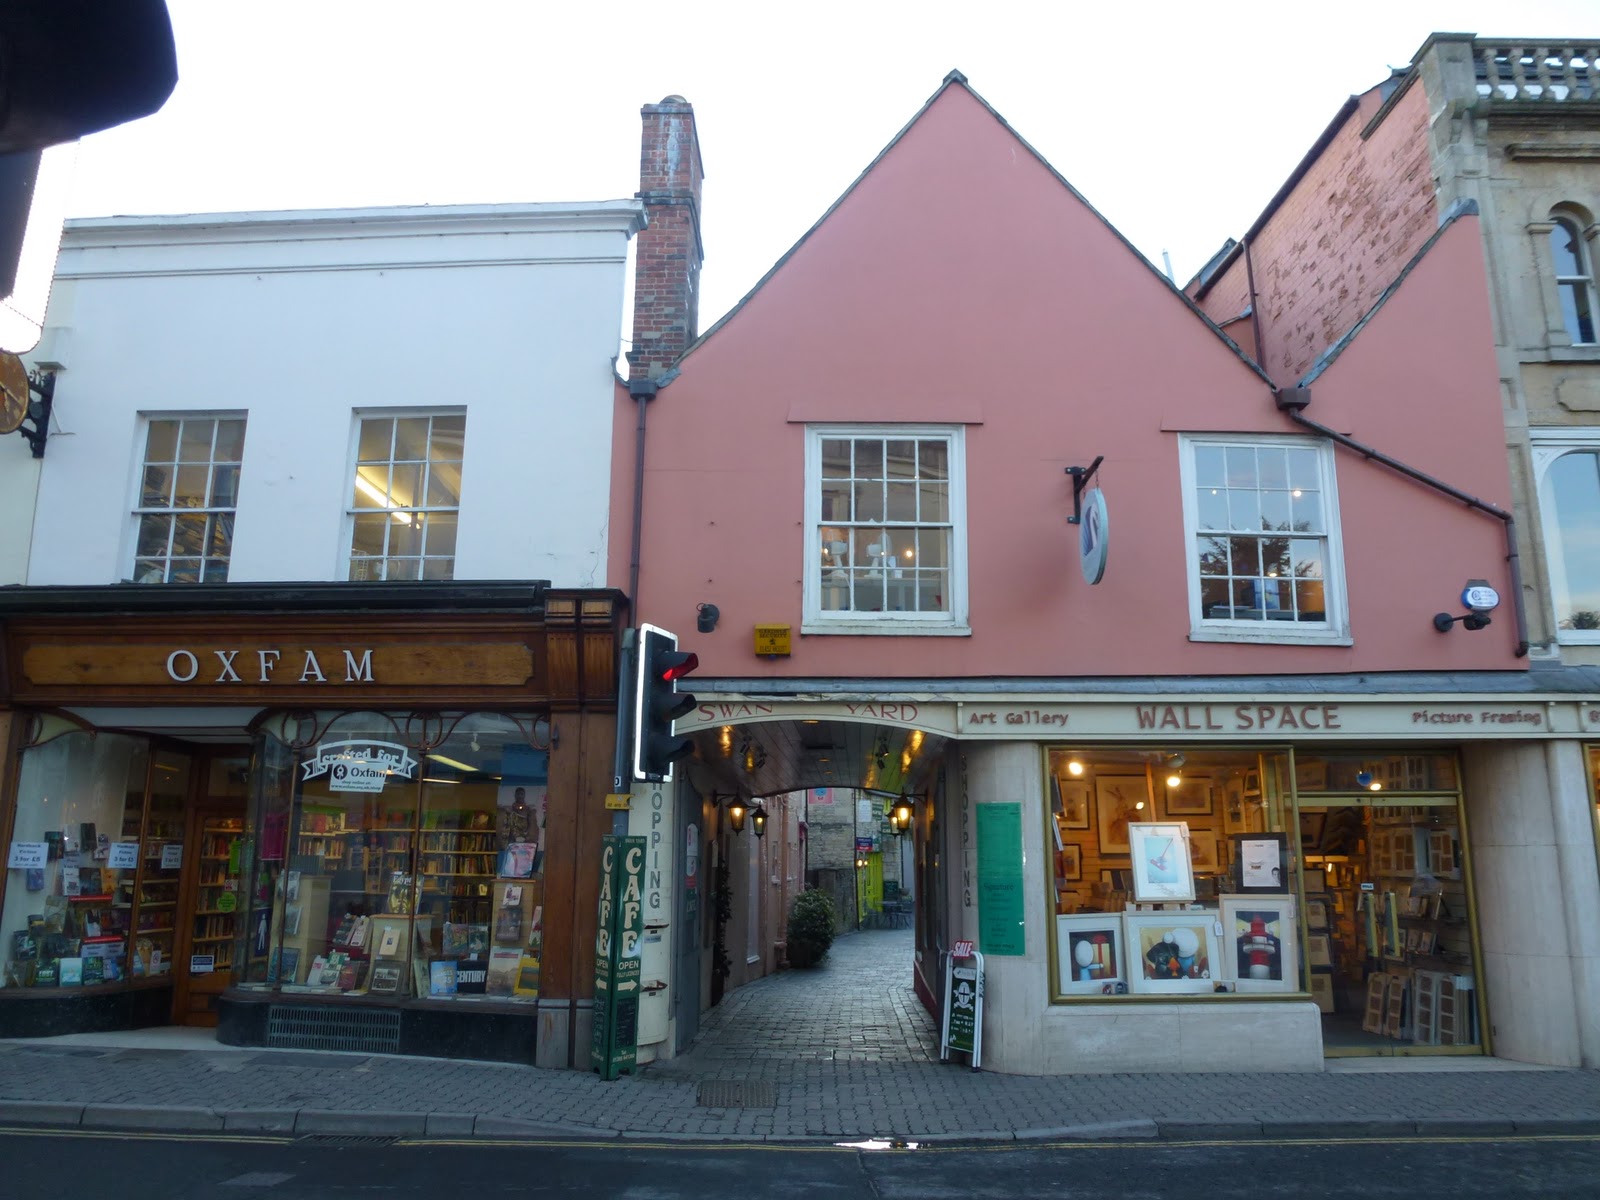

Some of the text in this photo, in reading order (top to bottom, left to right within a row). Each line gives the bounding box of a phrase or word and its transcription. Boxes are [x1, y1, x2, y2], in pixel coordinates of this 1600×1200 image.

[166, 649, 374, 682] OXFAM
[698, 703, 918, 722] SWAN YARD
[969, 710, 1069, 726] Art Gallery
[1136, 705, 1342, 729] WALL SPACE
[1412, 710, 1542, 726] Picture Framing
[378, 749, 400, 764] for
[350, 766, 385, 779] Oxfam
[961, 753, 971, 908] SHOPPING
[598, 846, 612, 957] CAFE
[622, 847, 642, 959] CAFE
[953, 942, 972, 957] SALE
[618, 960, 640, 970] OPEN
[457, 970, 486, 983] CENTURY
